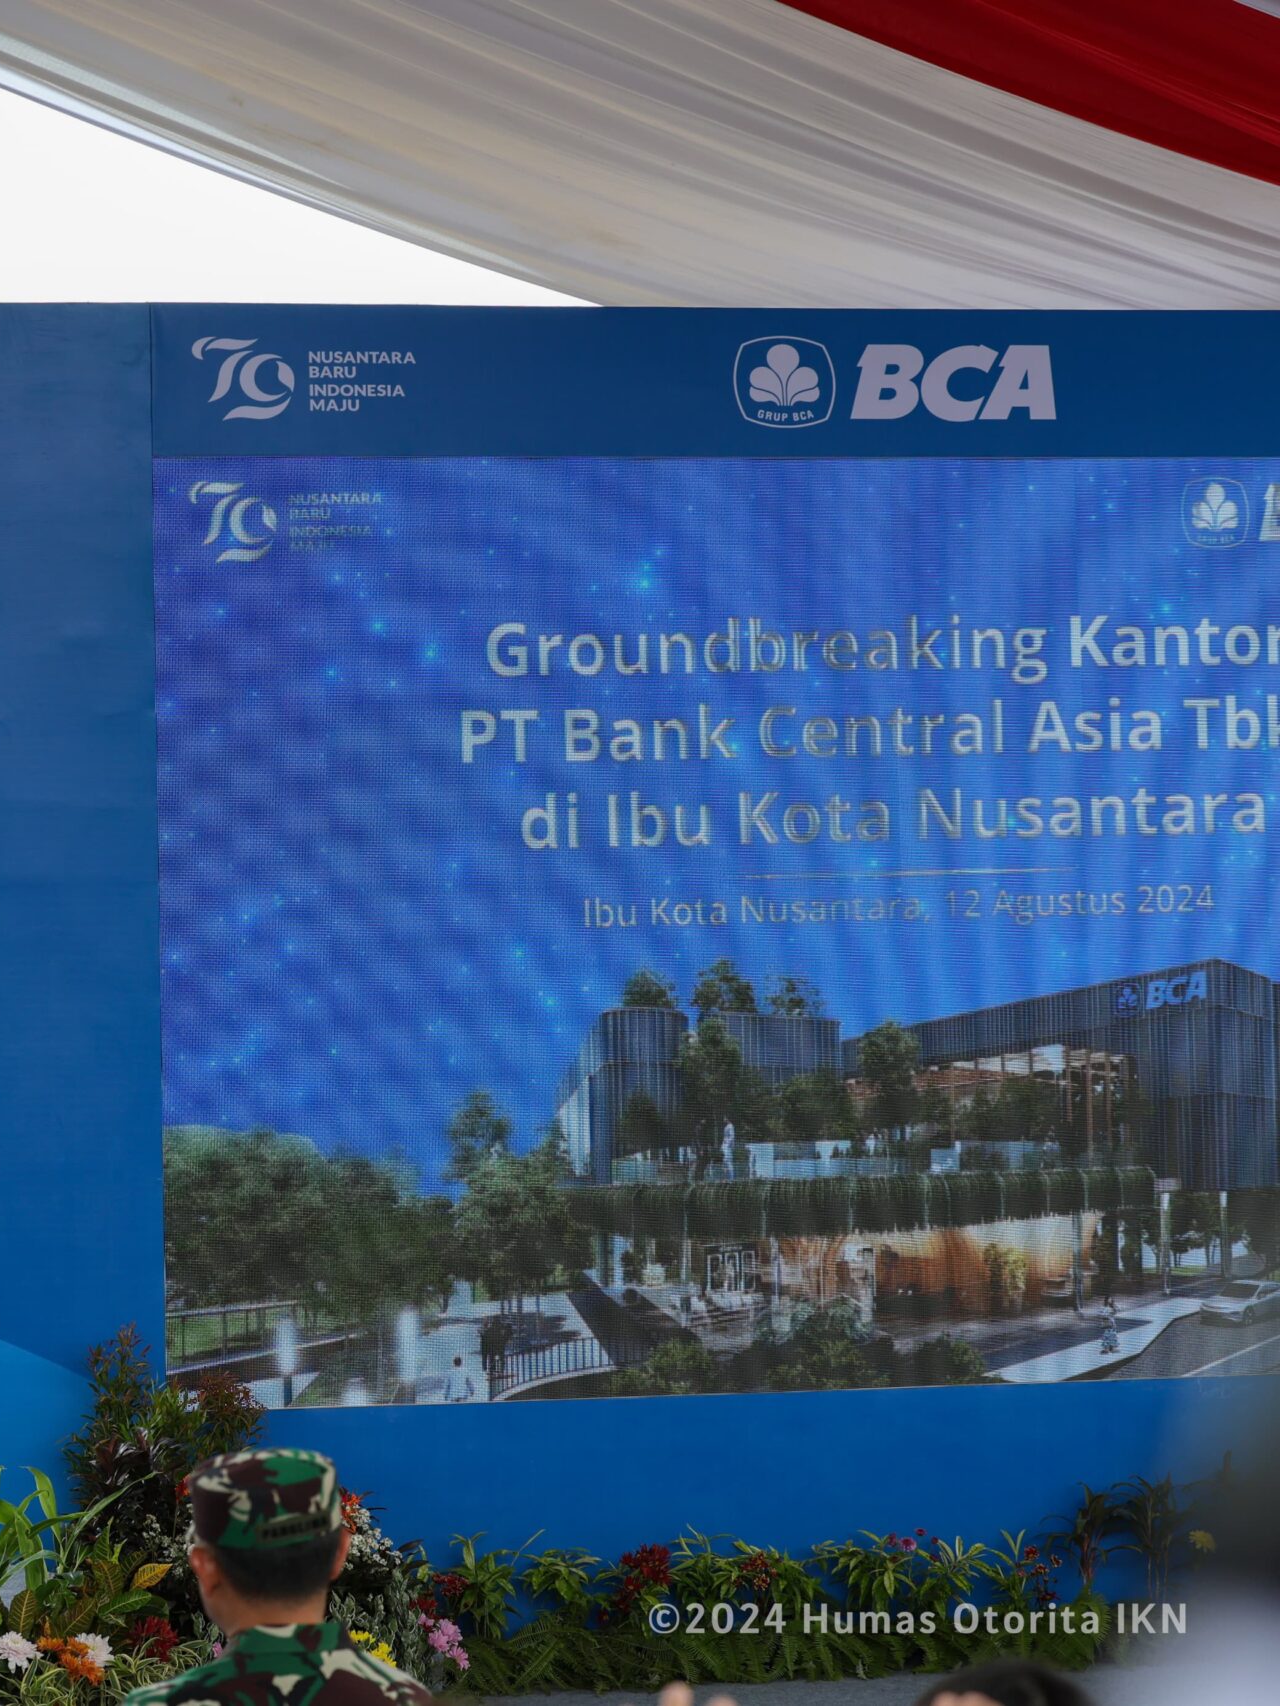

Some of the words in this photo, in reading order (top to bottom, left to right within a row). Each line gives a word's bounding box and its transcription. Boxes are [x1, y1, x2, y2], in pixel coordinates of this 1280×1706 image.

[308, 351, 417, 365] NUSANTARA
[308, 365, 357, 379] BARU
[309, 383, 406, 398] INDONESIA
[850, 343, 1057, 422] BCA
[309, 398, 360, 412] MAJU
[757, 409, 789, 422] GRUP
[792, 409, 815, 422] BCA
[486, 614, 1049, 685] Groundbreaking
[461, 709, 540, 763] PT
[564, 703, 736, 762] Bank
[759, 699, 1004, 757] Central
[1028, 697, 1162, 752] Asia
[521, 793, 578, 849] di
[608, 791, 711, 848] Ibu
[738, 791, 891, 845] Kota
[919, 787, 1266, 841] Nusantara
[583, 897, 637, 928] Ibu
[651, 897, 728, 926] Kota
[740, 895, 930, 925] Nusantara,
[945, 888, 982, 918] 12
[992, 888, 1126, 925] Agustus
[1136, 884, 1215, 913] 2024
[1145, 970, 1207, 1010] BCA
